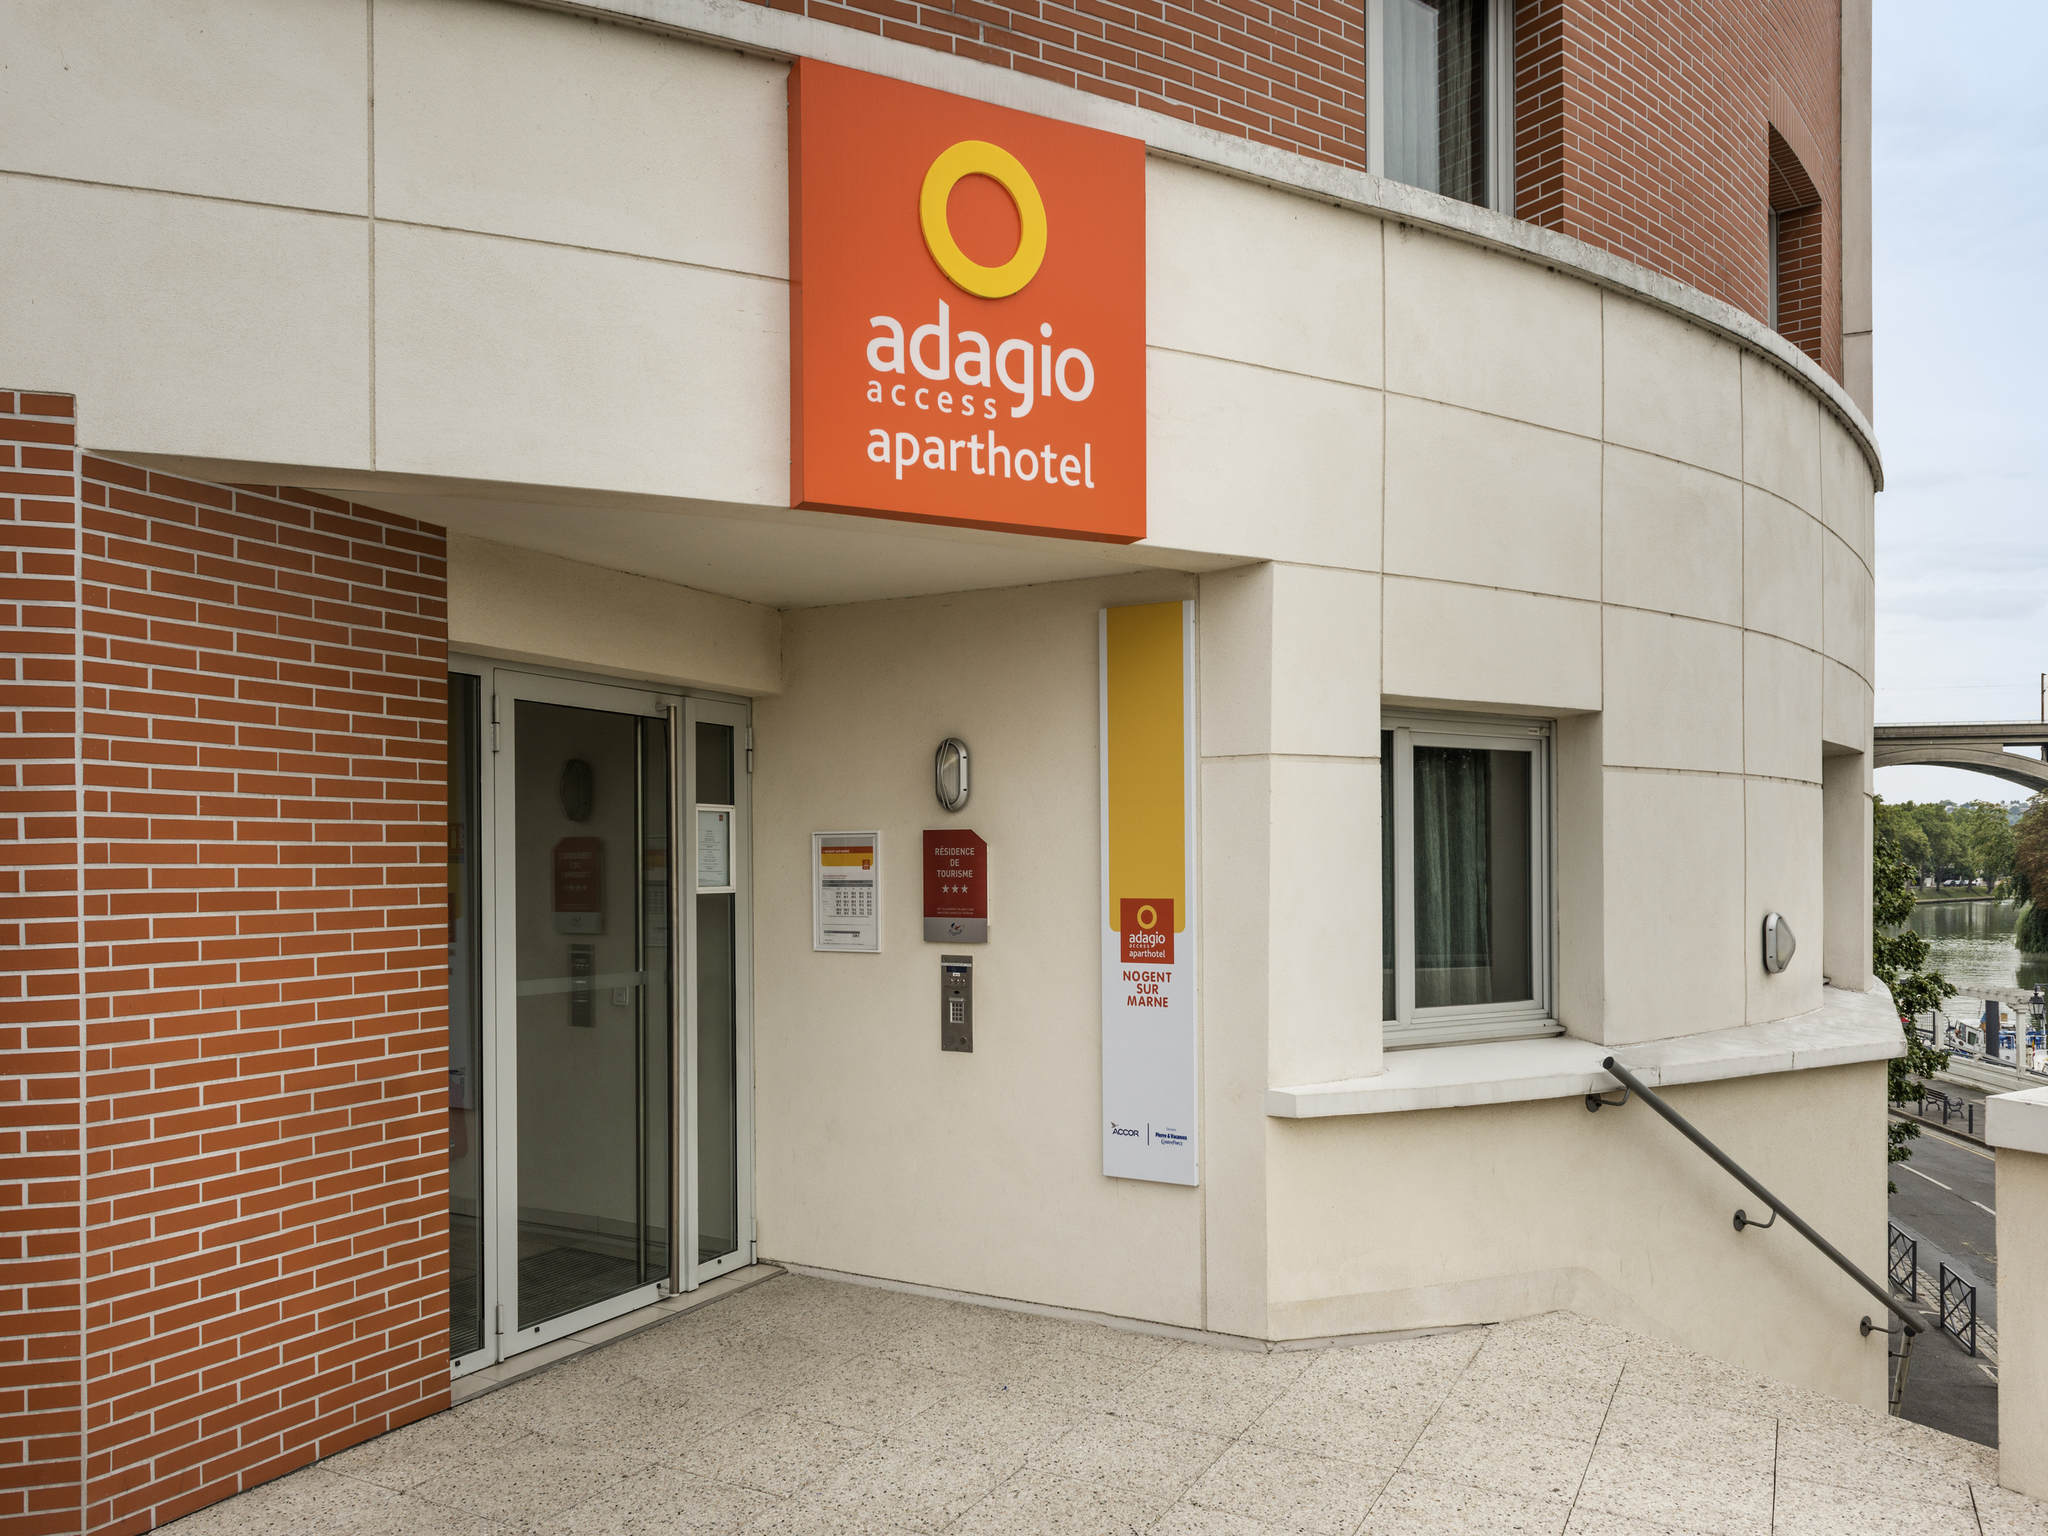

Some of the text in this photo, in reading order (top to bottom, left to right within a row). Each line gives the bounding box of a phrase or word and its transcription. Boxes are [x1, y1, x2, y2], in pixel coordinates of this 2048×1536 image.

[866, 297, 1095, 419] adagio
[866, 380, 997, 420] access
[866, 428, 1095, 489] aparthotel
[934, 846, 975, 856] RÉSIDENCE
[950, 858, 960, 867] DE
[936, 869, 973, 878] TOURISME
[1128, 930, 1166, 948] adagio
[1128, 949, 1166, 959] aparthotel
[1122, 970, 1172, 983] NOGENT
[1136, 983, 1159, 995] SUR
[1127, 995, 1169, 1008] MARNE
[1112, 1128, 1140, 1137] ACCOR
